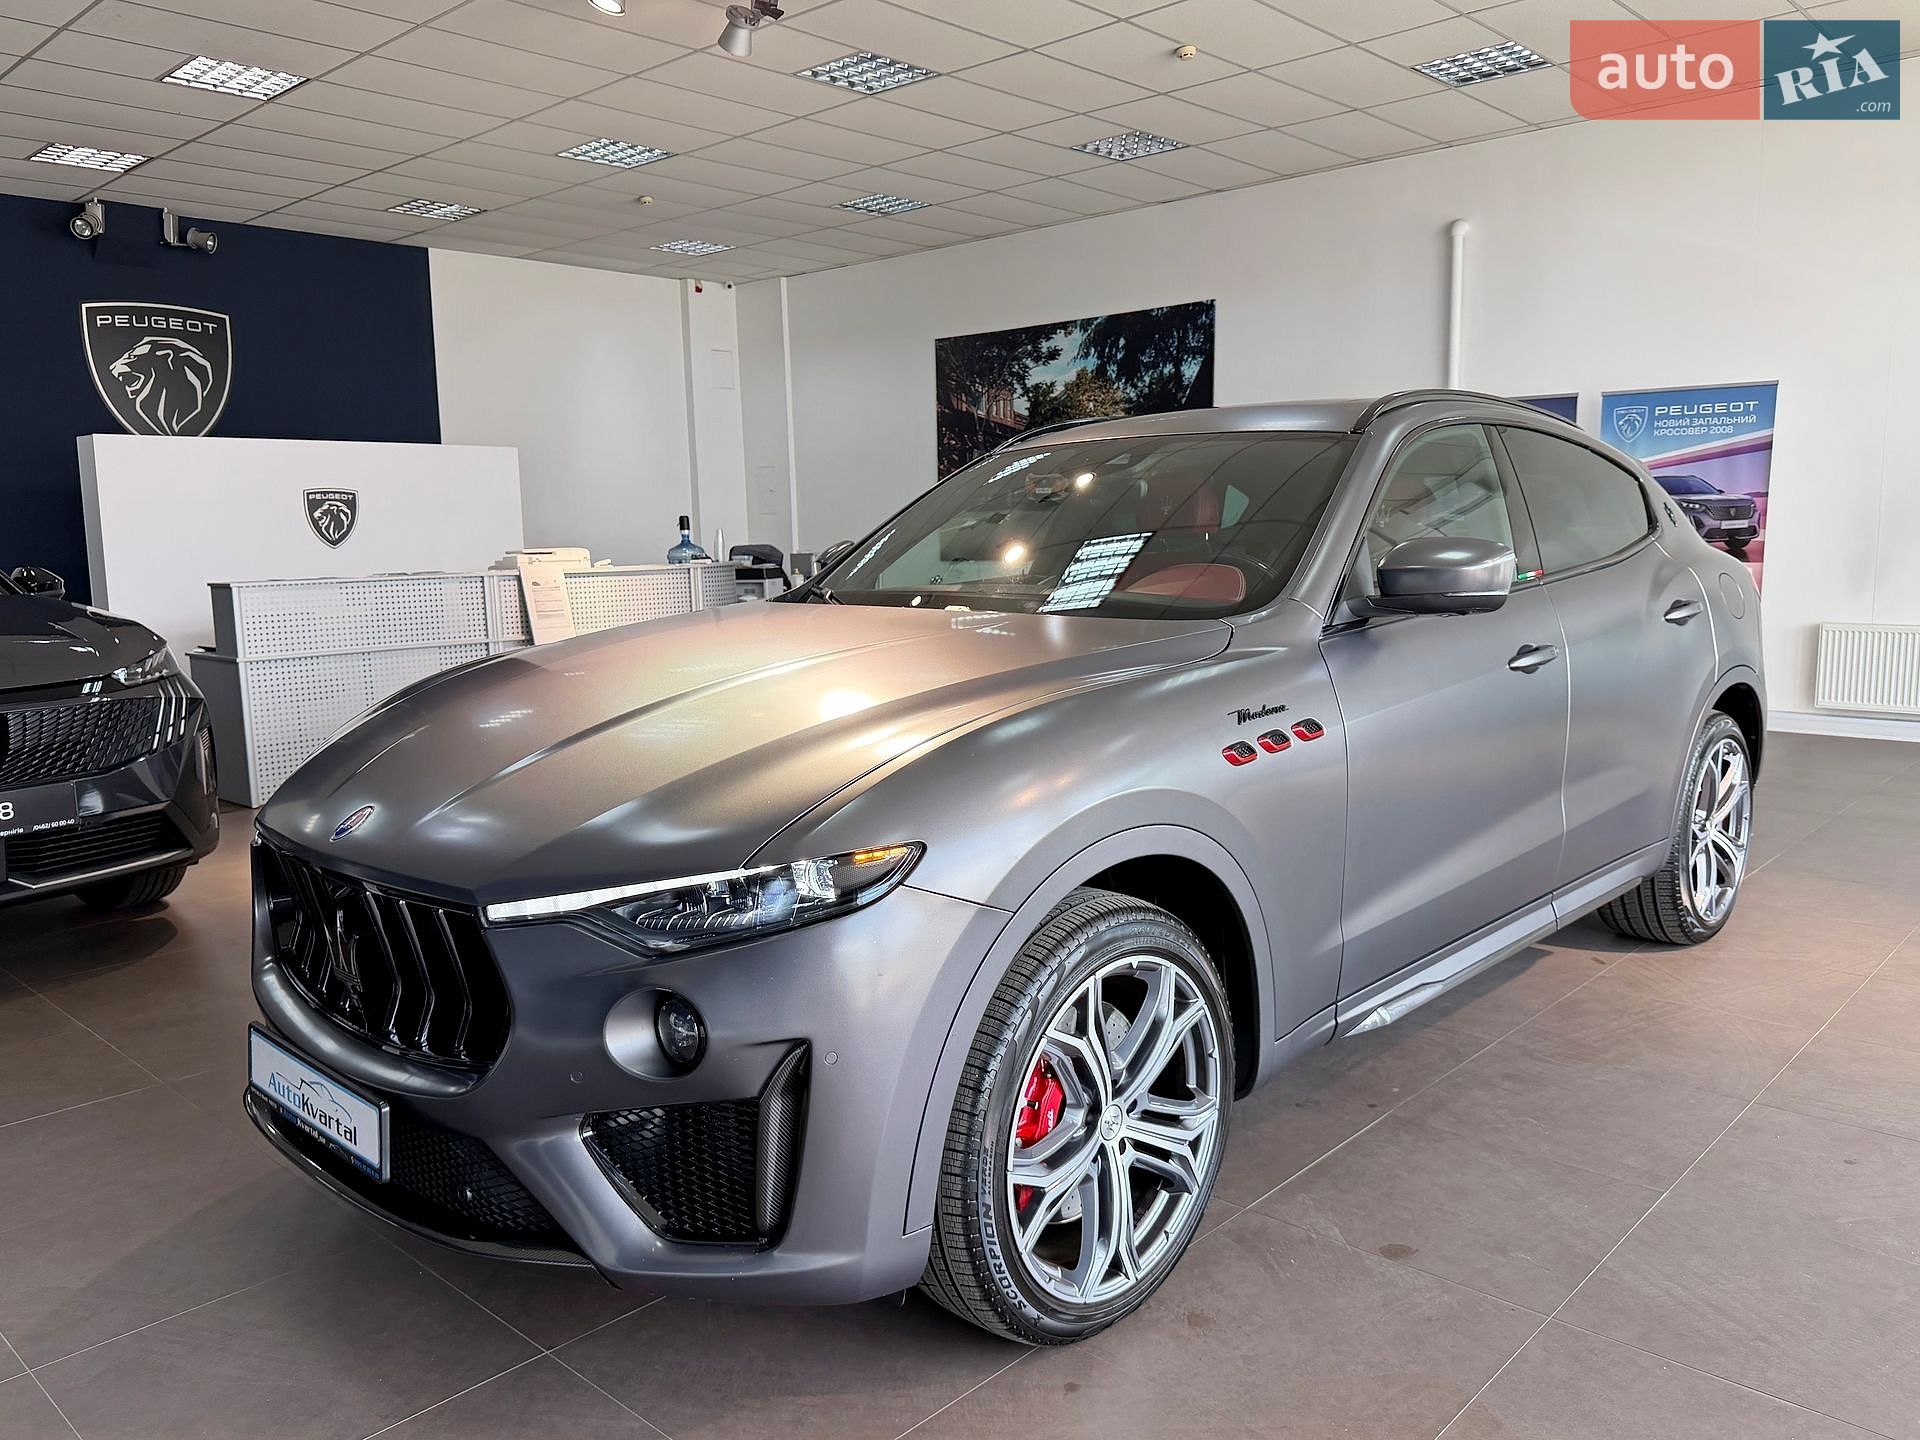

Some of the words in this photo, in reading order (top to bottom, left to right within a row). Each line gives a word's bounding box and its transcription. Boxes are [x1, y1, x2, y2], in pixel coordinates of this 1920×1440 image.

[96, 315, 218, 335] PEUGEOT
[1655, 401, 1759, 416] PEUGEOT
[1654, 418, 1690, 427] НОВИЙ
[1691, 414, 1757, 426] ЗАПАЛЬНИЙ
[1653, 426, 1708, 436] КРОСОВЕР
[1709, 425, 1734, 434] 2008
[309, 493, 354, 501] PEUGEOT
[268, 1071, 358, 1146] AutoKvartal
[981, 1202, 1028, 1311] SCORPION
